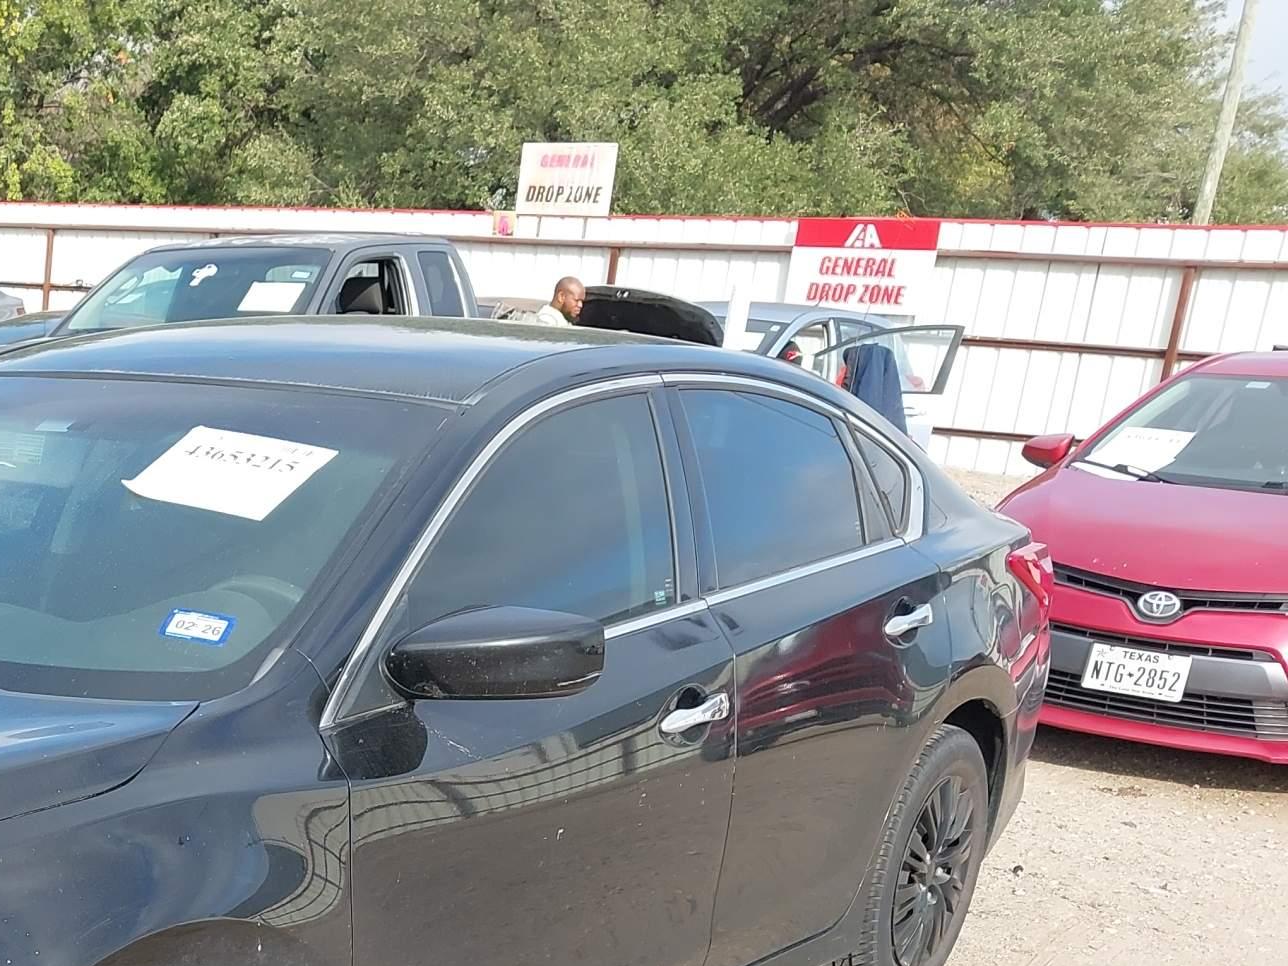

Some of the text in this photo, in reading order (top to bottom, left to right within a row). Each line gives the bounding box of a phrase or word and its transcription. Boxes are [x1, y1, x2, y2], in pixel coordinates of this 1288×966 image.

[525, 185, 603, 204] DROP ZONE
[819, 256, 896, 279] GENERAL
[806, 282, 906, 305] DROP ZONE
[1122, 650, 1160, 664] TEXAS
